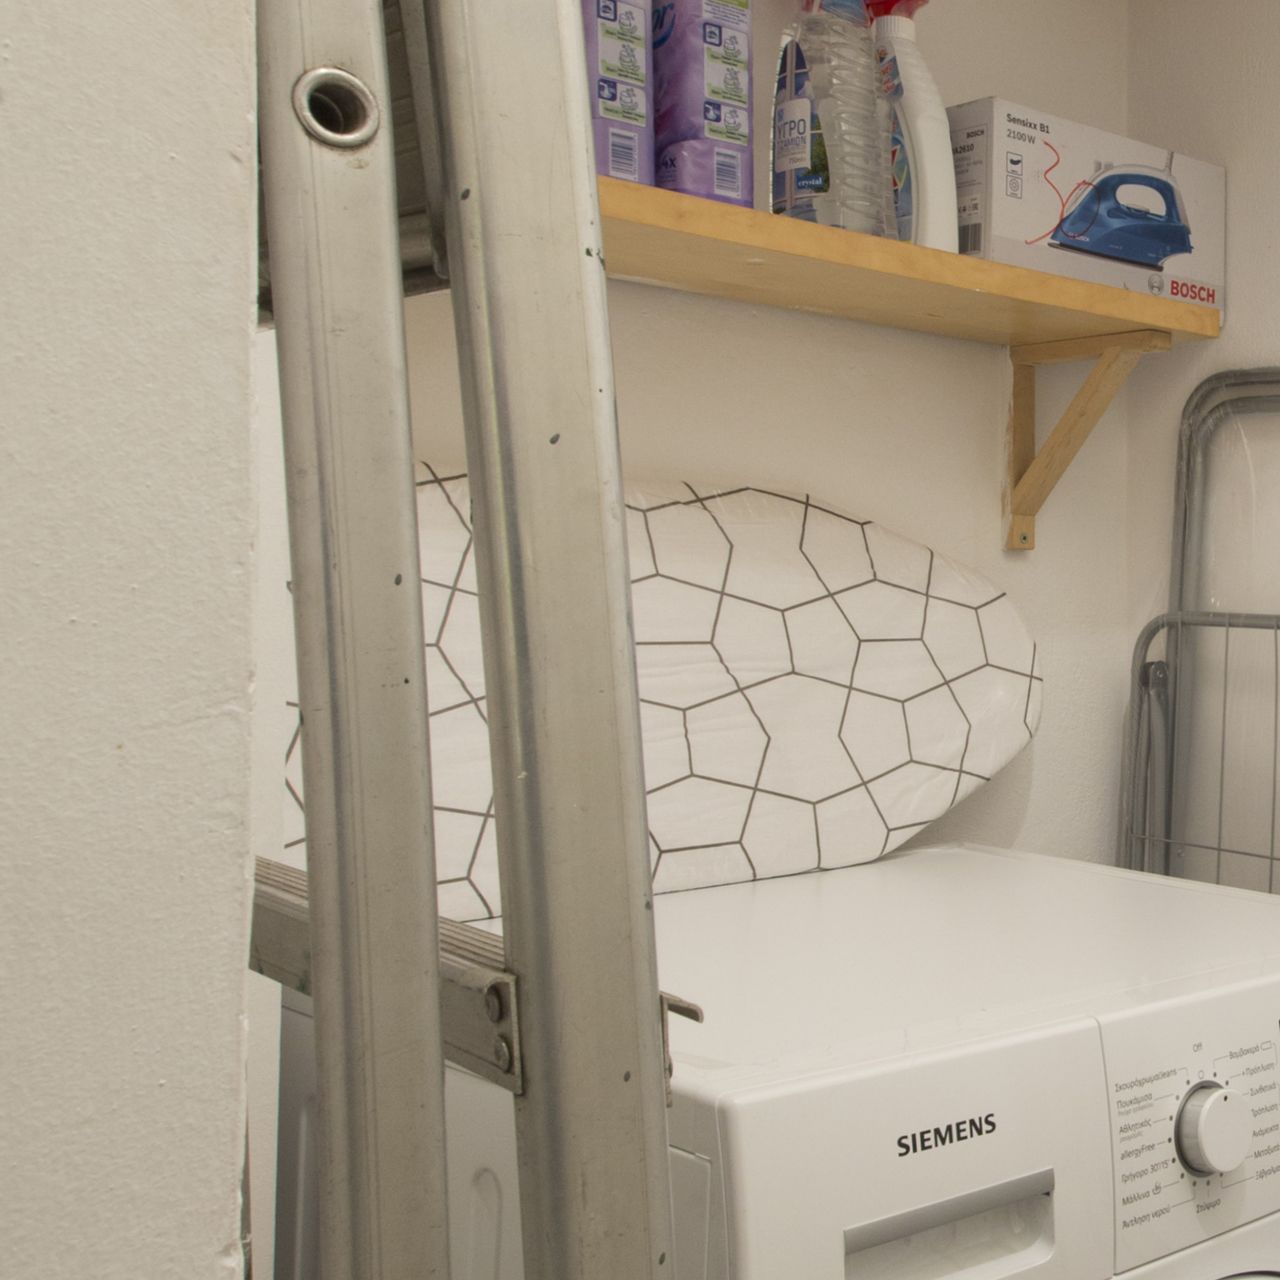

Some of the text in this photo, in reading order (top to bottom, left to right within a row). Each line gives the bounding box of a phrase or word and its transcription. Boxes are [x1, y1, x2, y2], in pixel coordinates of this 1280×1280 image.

[1006, 113, 1050, 135] Sensixx B1
[797, 176, 823, 188] crystal
[1170, 280, 1216, 305] BOSCH
[897, 1113, 996, 1157] SIEMENS
